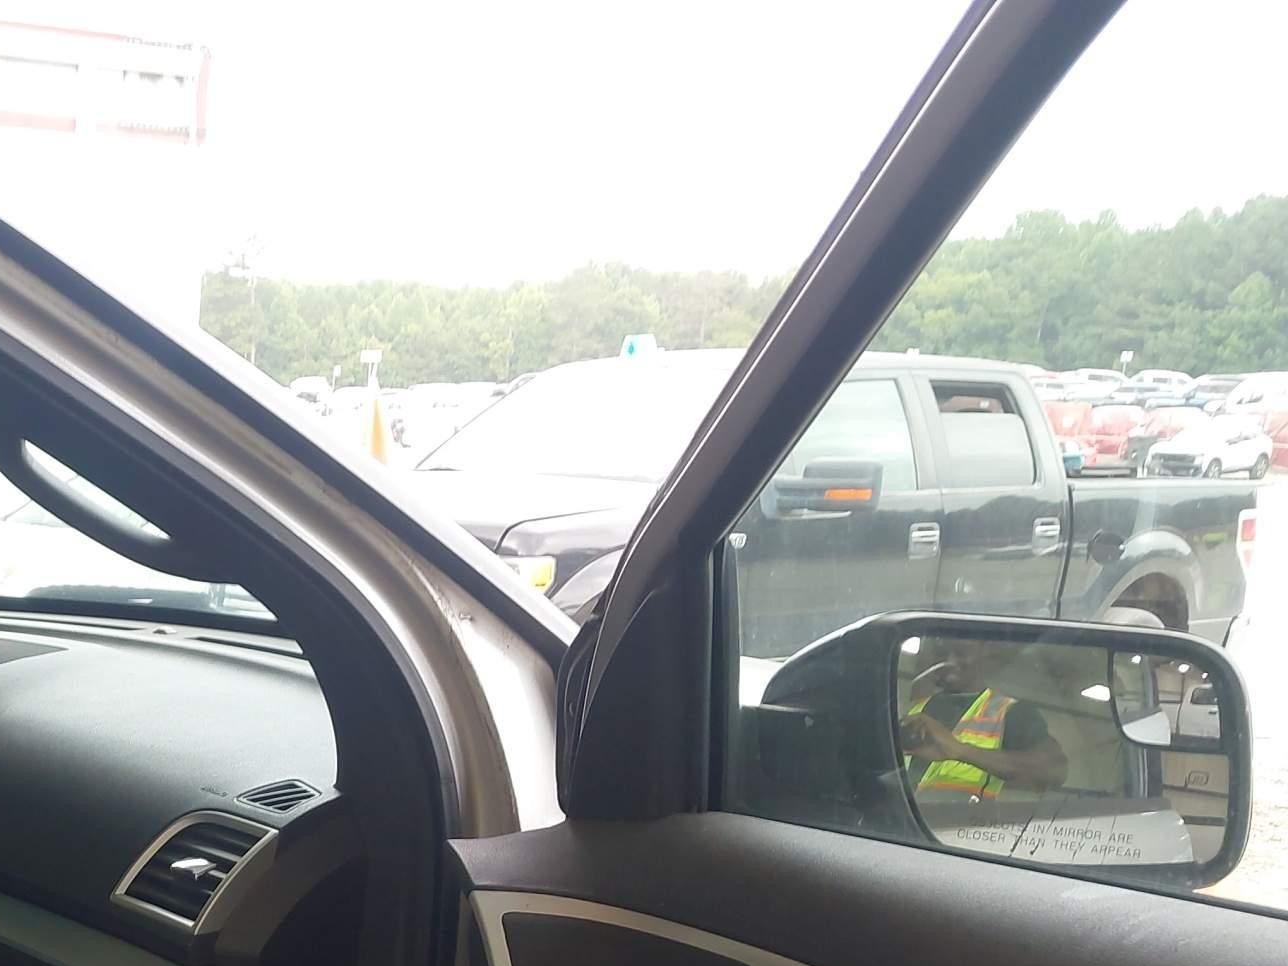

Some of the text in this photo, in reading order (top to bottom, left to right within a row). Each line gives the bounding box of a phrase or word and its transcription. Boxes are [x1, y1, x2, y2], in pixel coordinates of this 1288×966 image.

[956, 827, 1006, 843] CLOSER
[1054, 839, 1085, 852] THEY
[1091, 844, 1142, 859] APPEAR
[1032, 823, 1045, 834] IN
[1053, 826, 1101, 841] MIRROR
[1108, 832, 1134, 844] ARE
